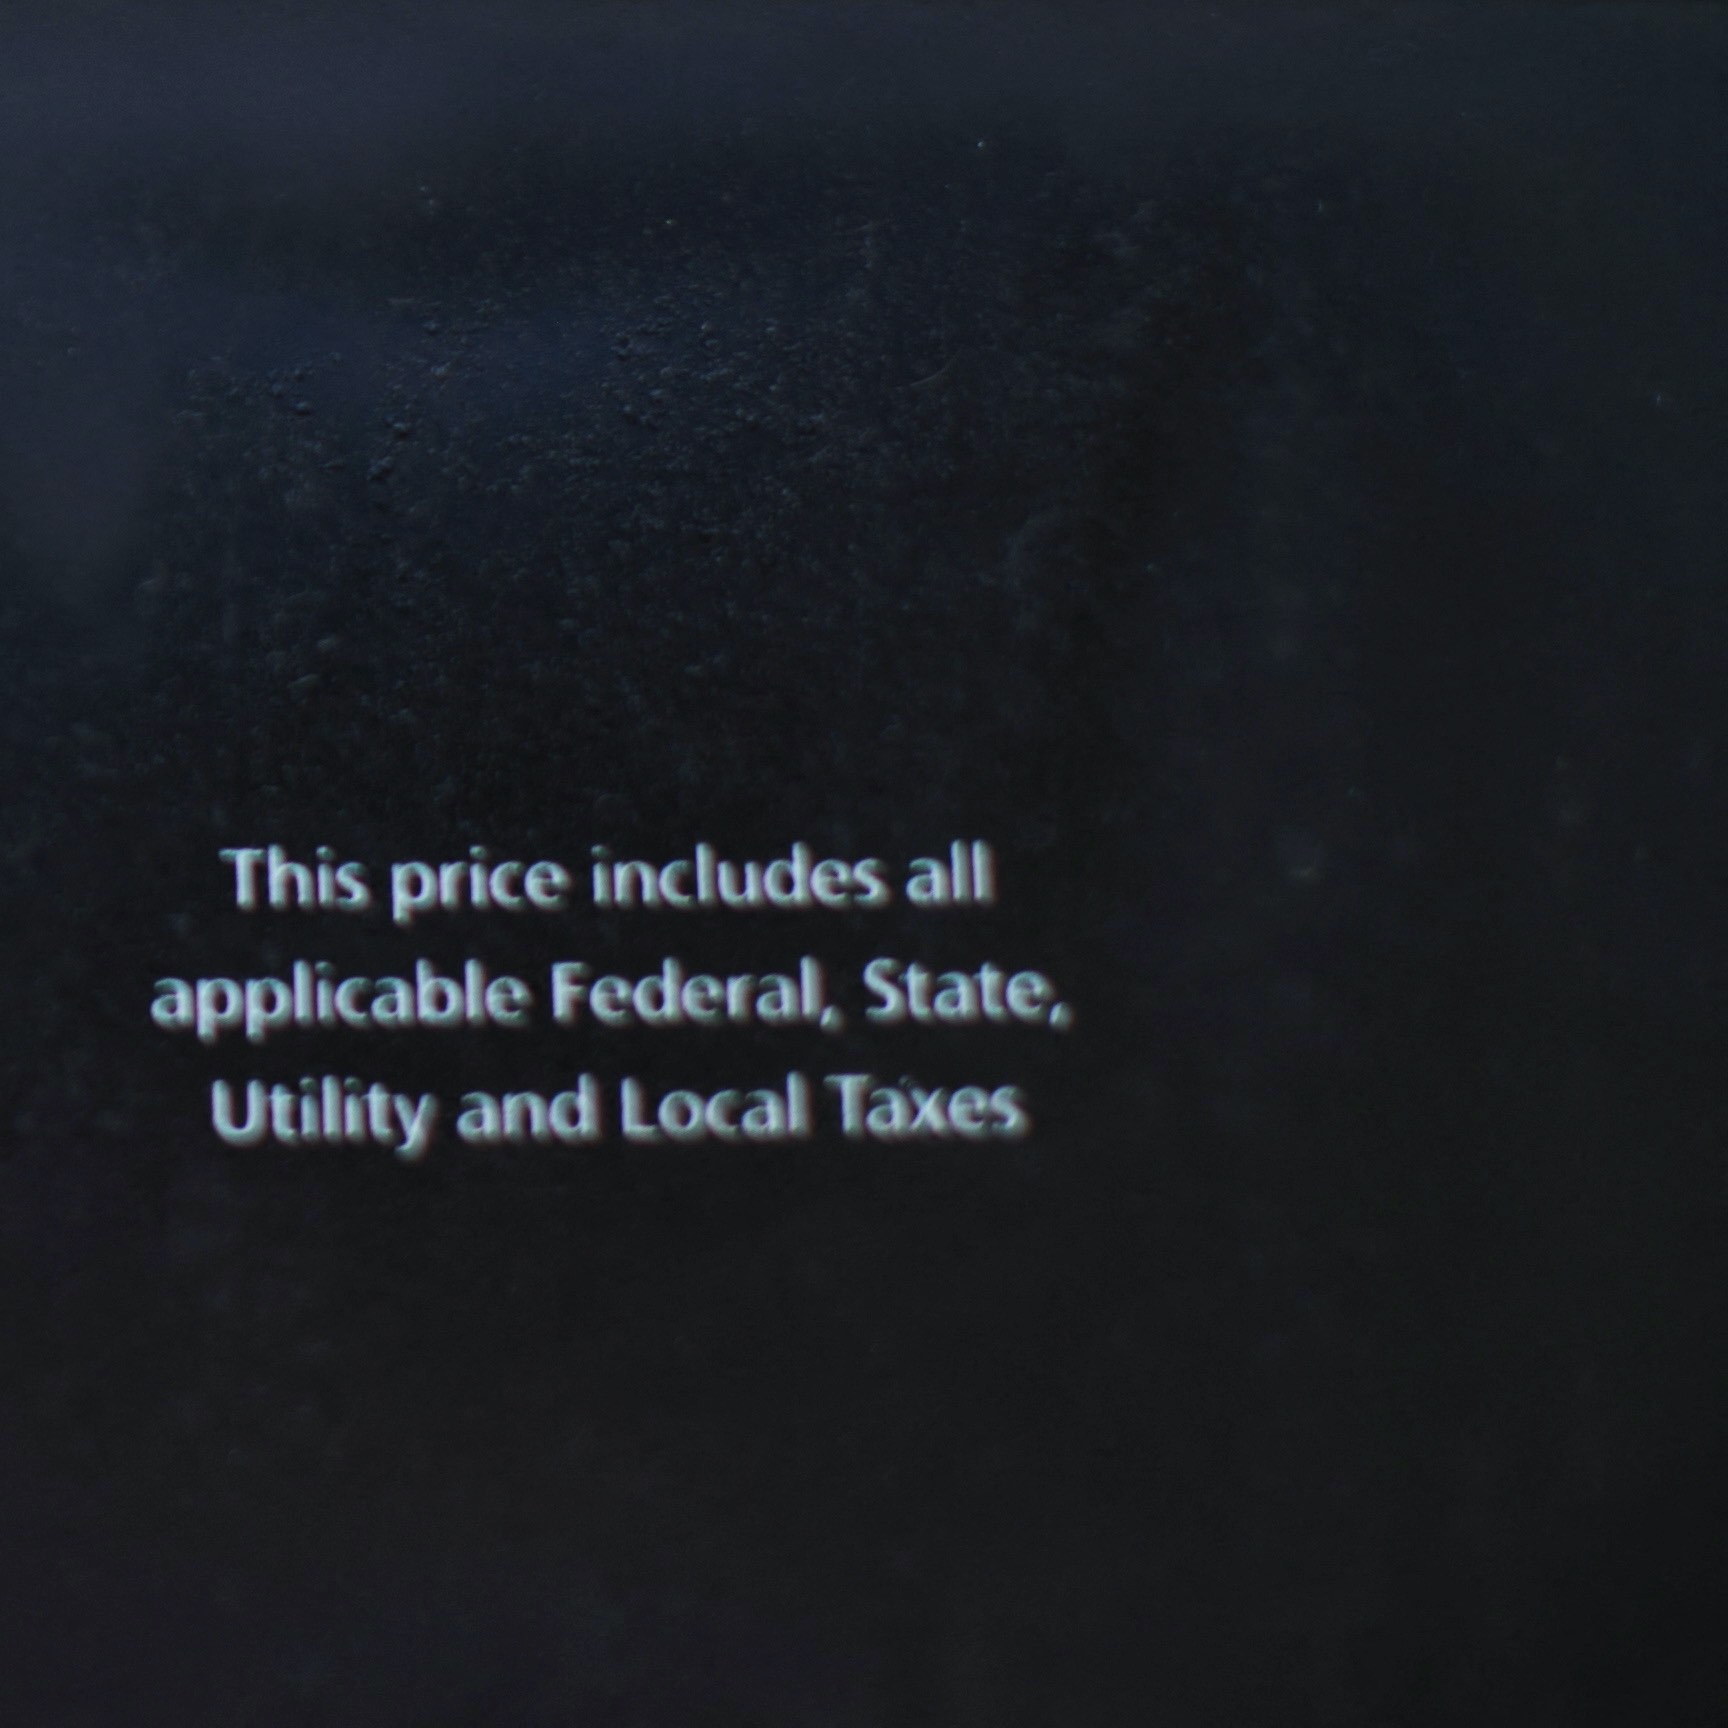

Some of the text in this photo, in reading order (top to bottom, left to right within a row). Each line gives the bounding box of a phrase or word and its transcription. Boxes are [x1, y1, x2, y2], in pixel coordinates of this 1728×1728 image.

[221, 841, 990, 921] This price includes all
[151, 957, 1067, 1038] applicable Federal, State,
[212, 1073, 1024, 1153] Utility and Local Taxes
